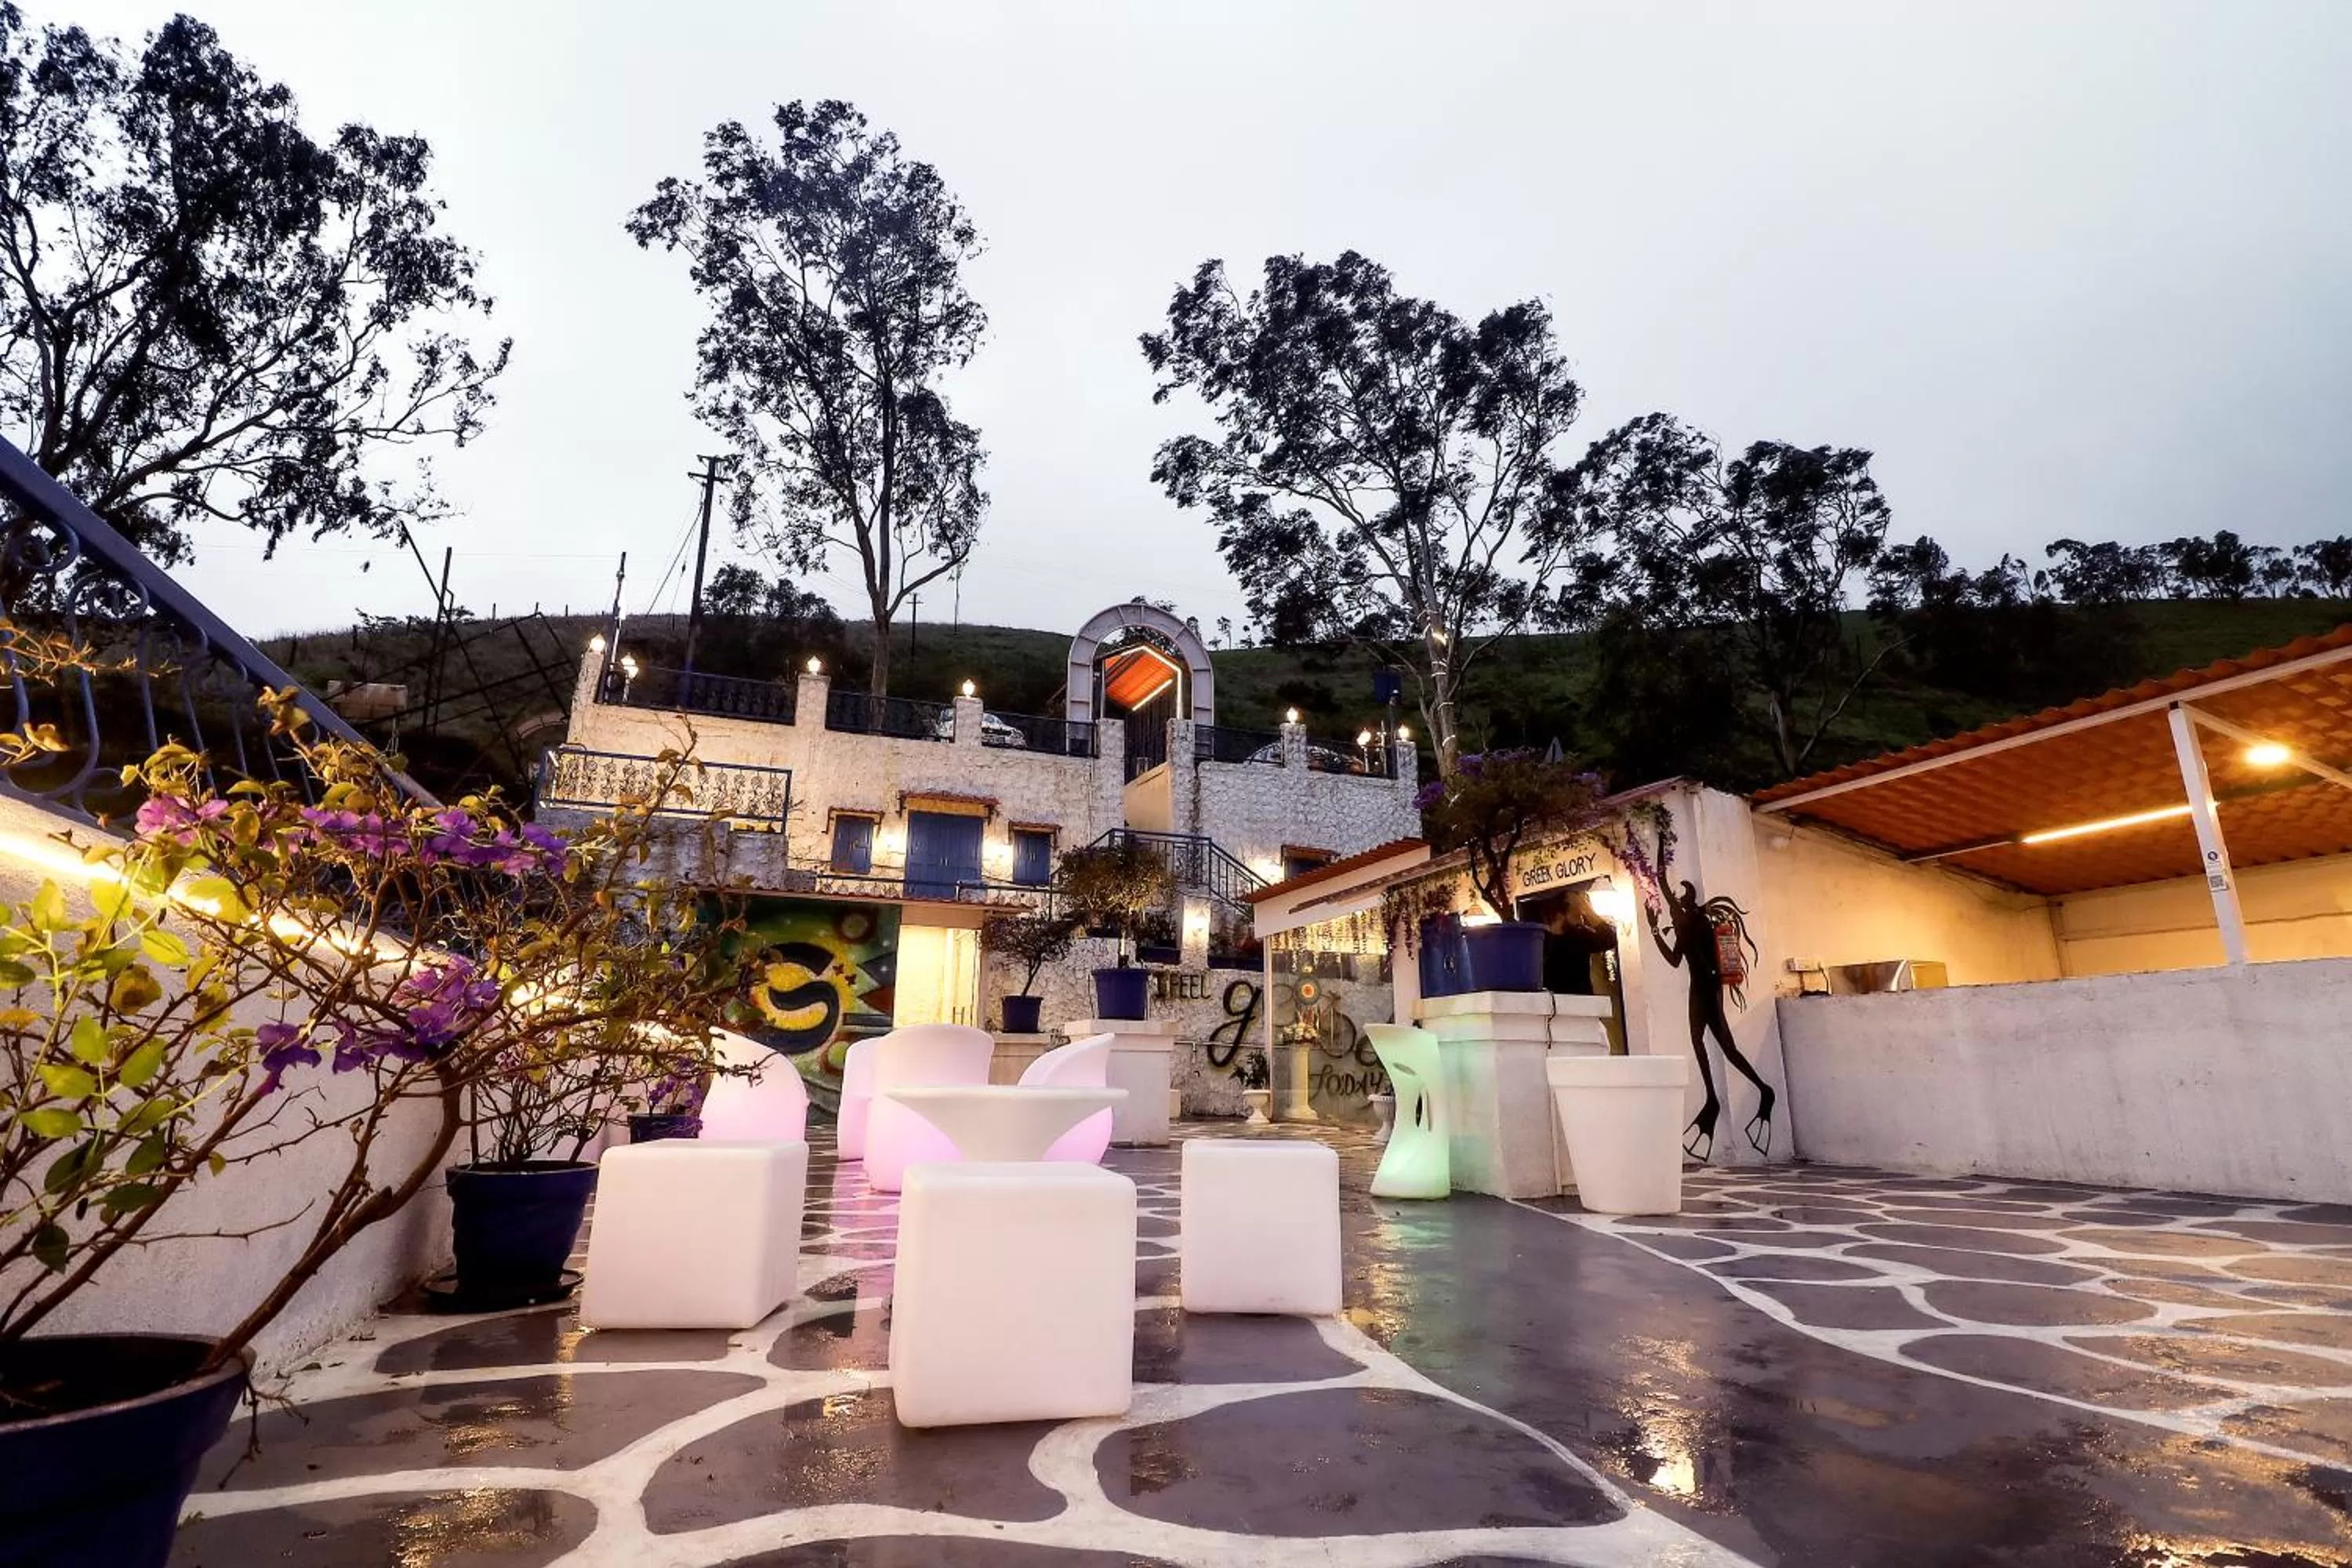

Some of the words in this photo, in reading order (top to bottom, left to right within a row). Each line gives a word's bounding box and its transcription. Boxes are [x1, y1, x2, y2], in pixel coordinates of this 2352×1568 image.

[1523, 865, 1553, 886] GREEK
[1555, 852, 1596, 878] GLORY
[1170, 970, 1211, 1000] FEEL
